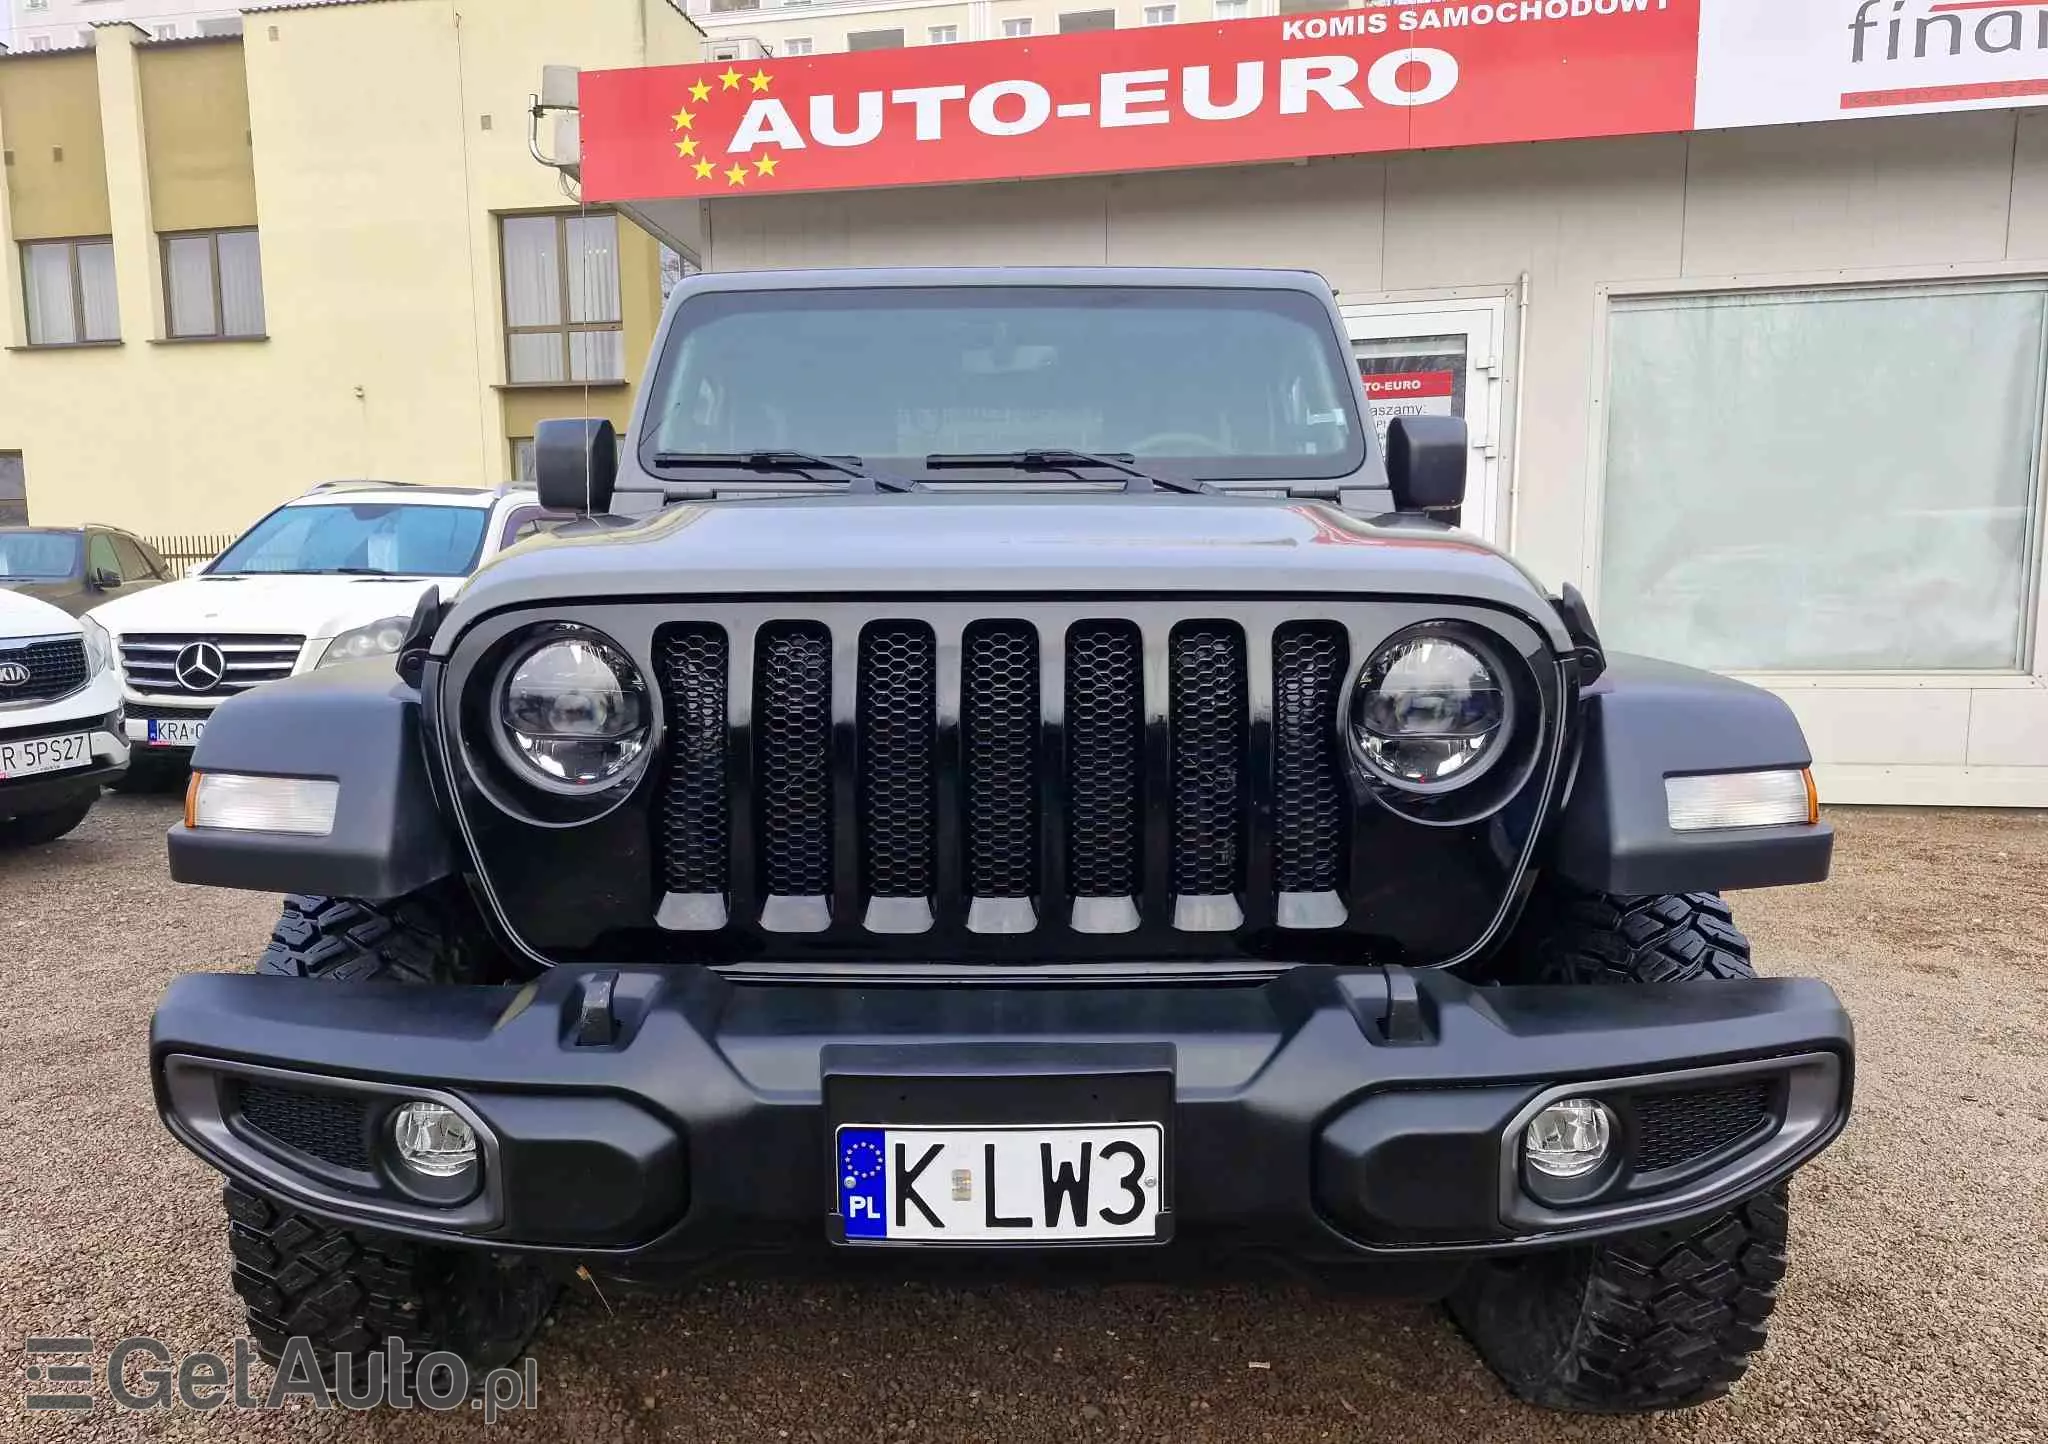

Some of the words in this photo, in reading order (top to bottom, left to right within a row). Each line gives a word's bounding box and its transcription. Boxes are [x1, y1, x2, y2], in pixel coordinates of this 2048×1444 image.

[1282, 12, 1388, 41] KOMIS
[726, 46, 1460, 153] AUTO-EURO
[158, 722, 189, 741] KRA
[24, 735, 84, 767] 5PS27
[895, 1143, 945, 1228] K
[984, 1140, 1146, 1228] LW3
[849, 1195, 881, 1219] PL
